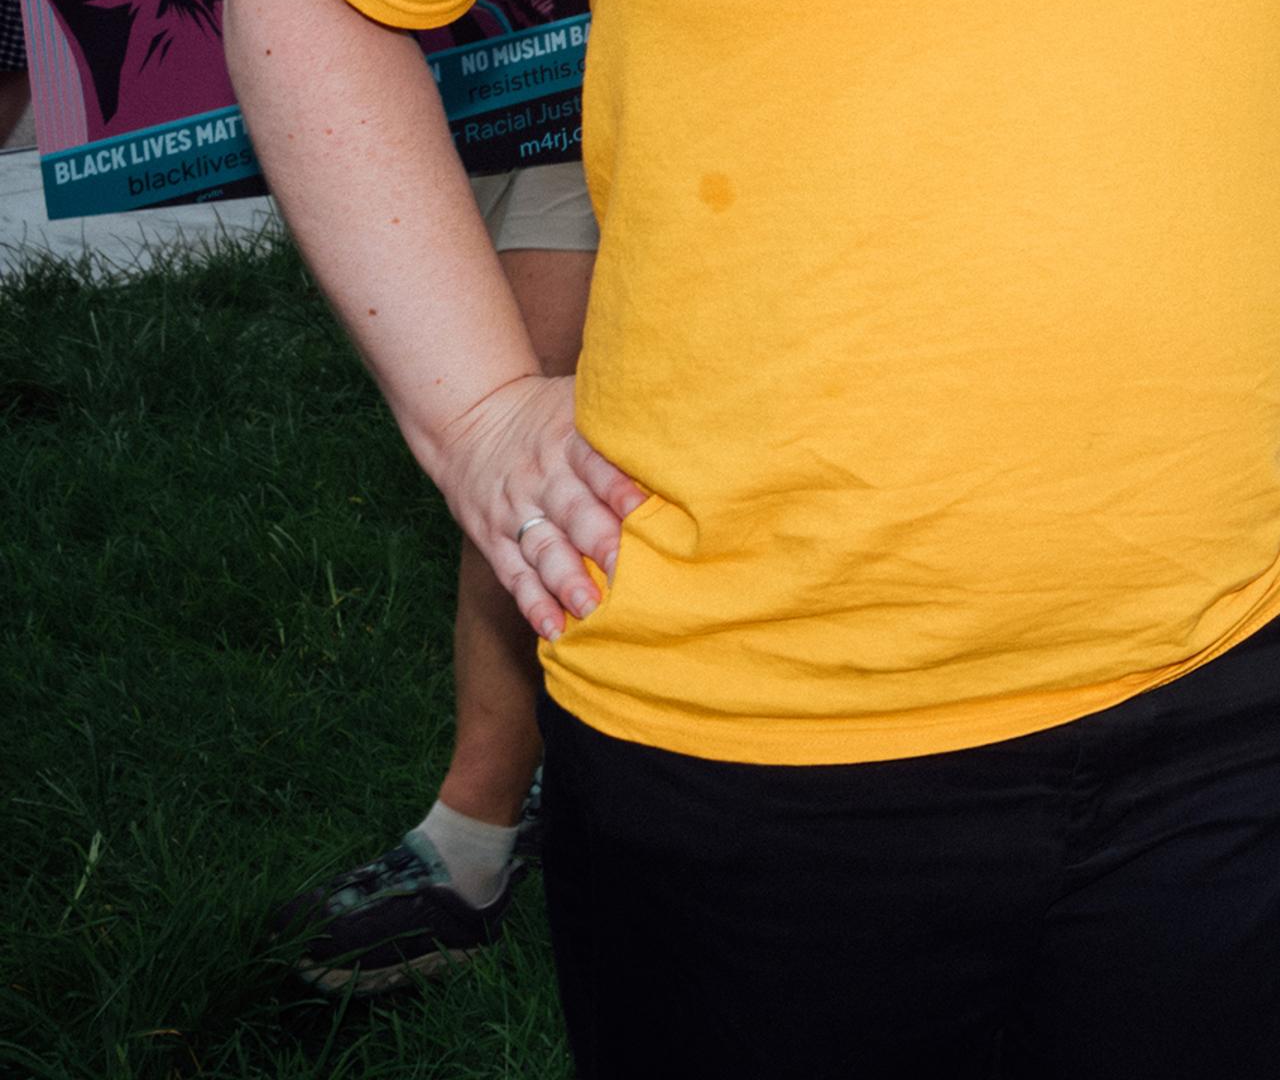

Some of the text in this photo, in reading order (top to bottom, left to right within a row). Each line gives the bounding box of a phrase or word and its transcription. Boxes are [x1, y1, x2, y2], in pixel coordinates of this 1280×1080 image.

[461, 50, 489, 76] NO
[493, 29, 567, 68] MUSLIM
[464, 106, 532, 144] Racial
[54, 145, 127, 185] BLACK
[130, 128, 192, 165] LIVES
